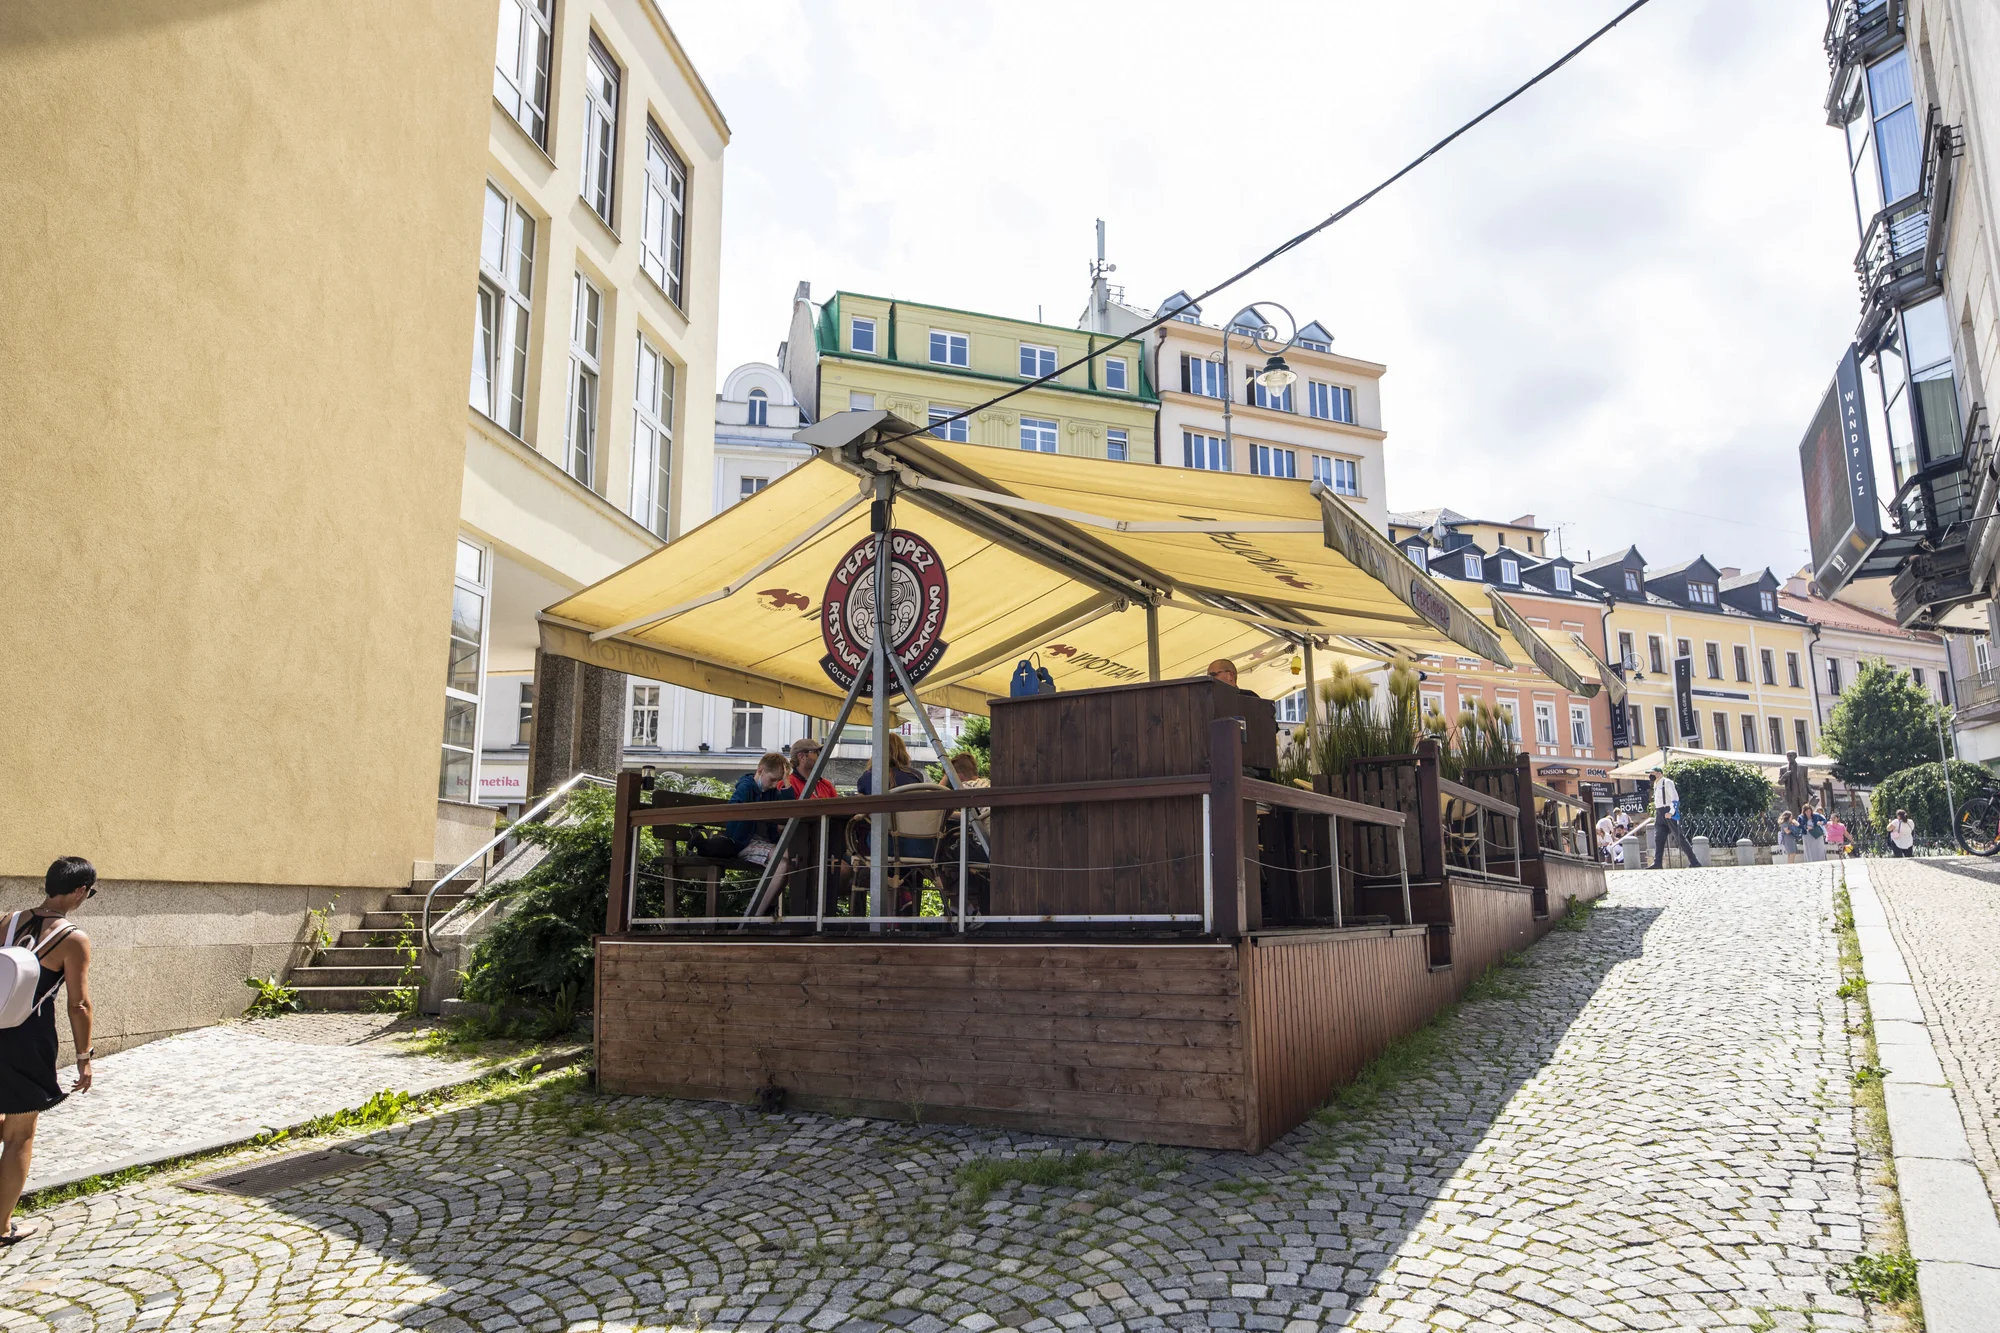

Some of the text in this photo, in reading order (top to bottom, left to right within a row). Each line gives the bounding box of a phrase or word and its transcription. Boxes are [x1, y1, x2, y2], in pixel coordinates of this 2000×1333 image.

[1844, 390, 1865, 496] WANDP.CZ
[836, 536, 934, 585] PEPE OPEZ
[898, 585, 941, 666] MEXICANO
[919, 647, 940, 671] CLUB
[456, 776, 520, 787] kometika
[1586, 768, 1607, 778] ROMA
[1620, 804, 1644, 813] ROMA
